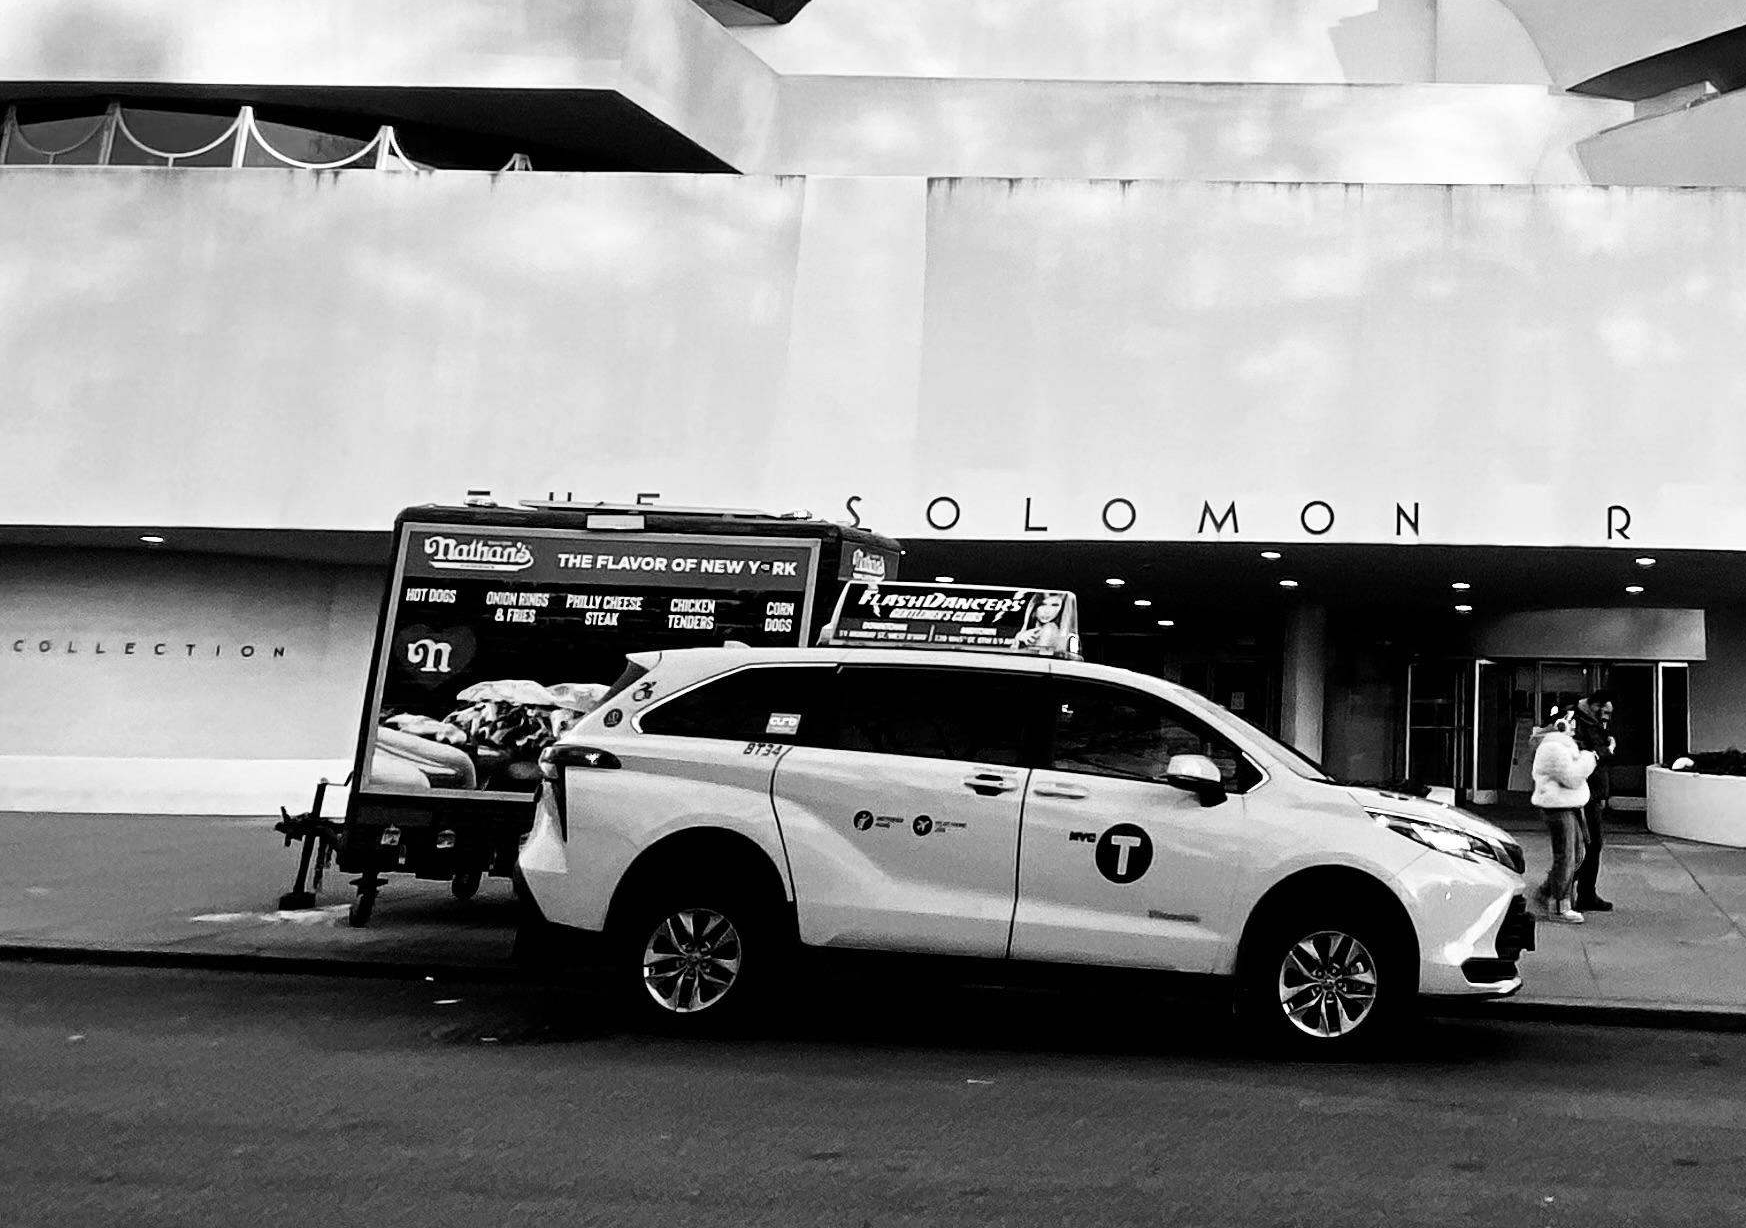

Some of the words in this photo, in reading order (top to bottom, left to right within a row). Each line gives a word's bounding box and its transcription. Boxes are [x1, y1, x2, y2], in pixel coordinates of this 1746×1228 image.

[846, 495, 1419, 536] SOLOMON
[1607, 505, 1631, 540] R
[424, 535, 533, 565] Nathan's
[558, 554, 593, 568] THE
[596, 555, 667, 571] FLAVOR
[671, 558, 698, 572] OF
[700, 559, 744, 574] NEW
[405, 588, 428, 601] HOT
[428, 589, 457, 603] DOGS
[486, 591, 518, 605] ONION
[519, 593, 550, 607] RINGS
[566, 594, 602, 609] PHILLY
[603, 596, 644, 611] CHEESE
[670, 598, 716, 614] CHICKEN
[766, 601, 794, 616] CORN
[494, 608, 505, 622] &
[506, 608, 536, 623] FRIES
[584, 612, 620, 626] STEAK
[668, 614, 715, 630] TENDERS
[764, 618, 793, 632] DOGS
[12, 639, 285, 658] COLLECTION
[1069, 831, 1097, 843] NYC
